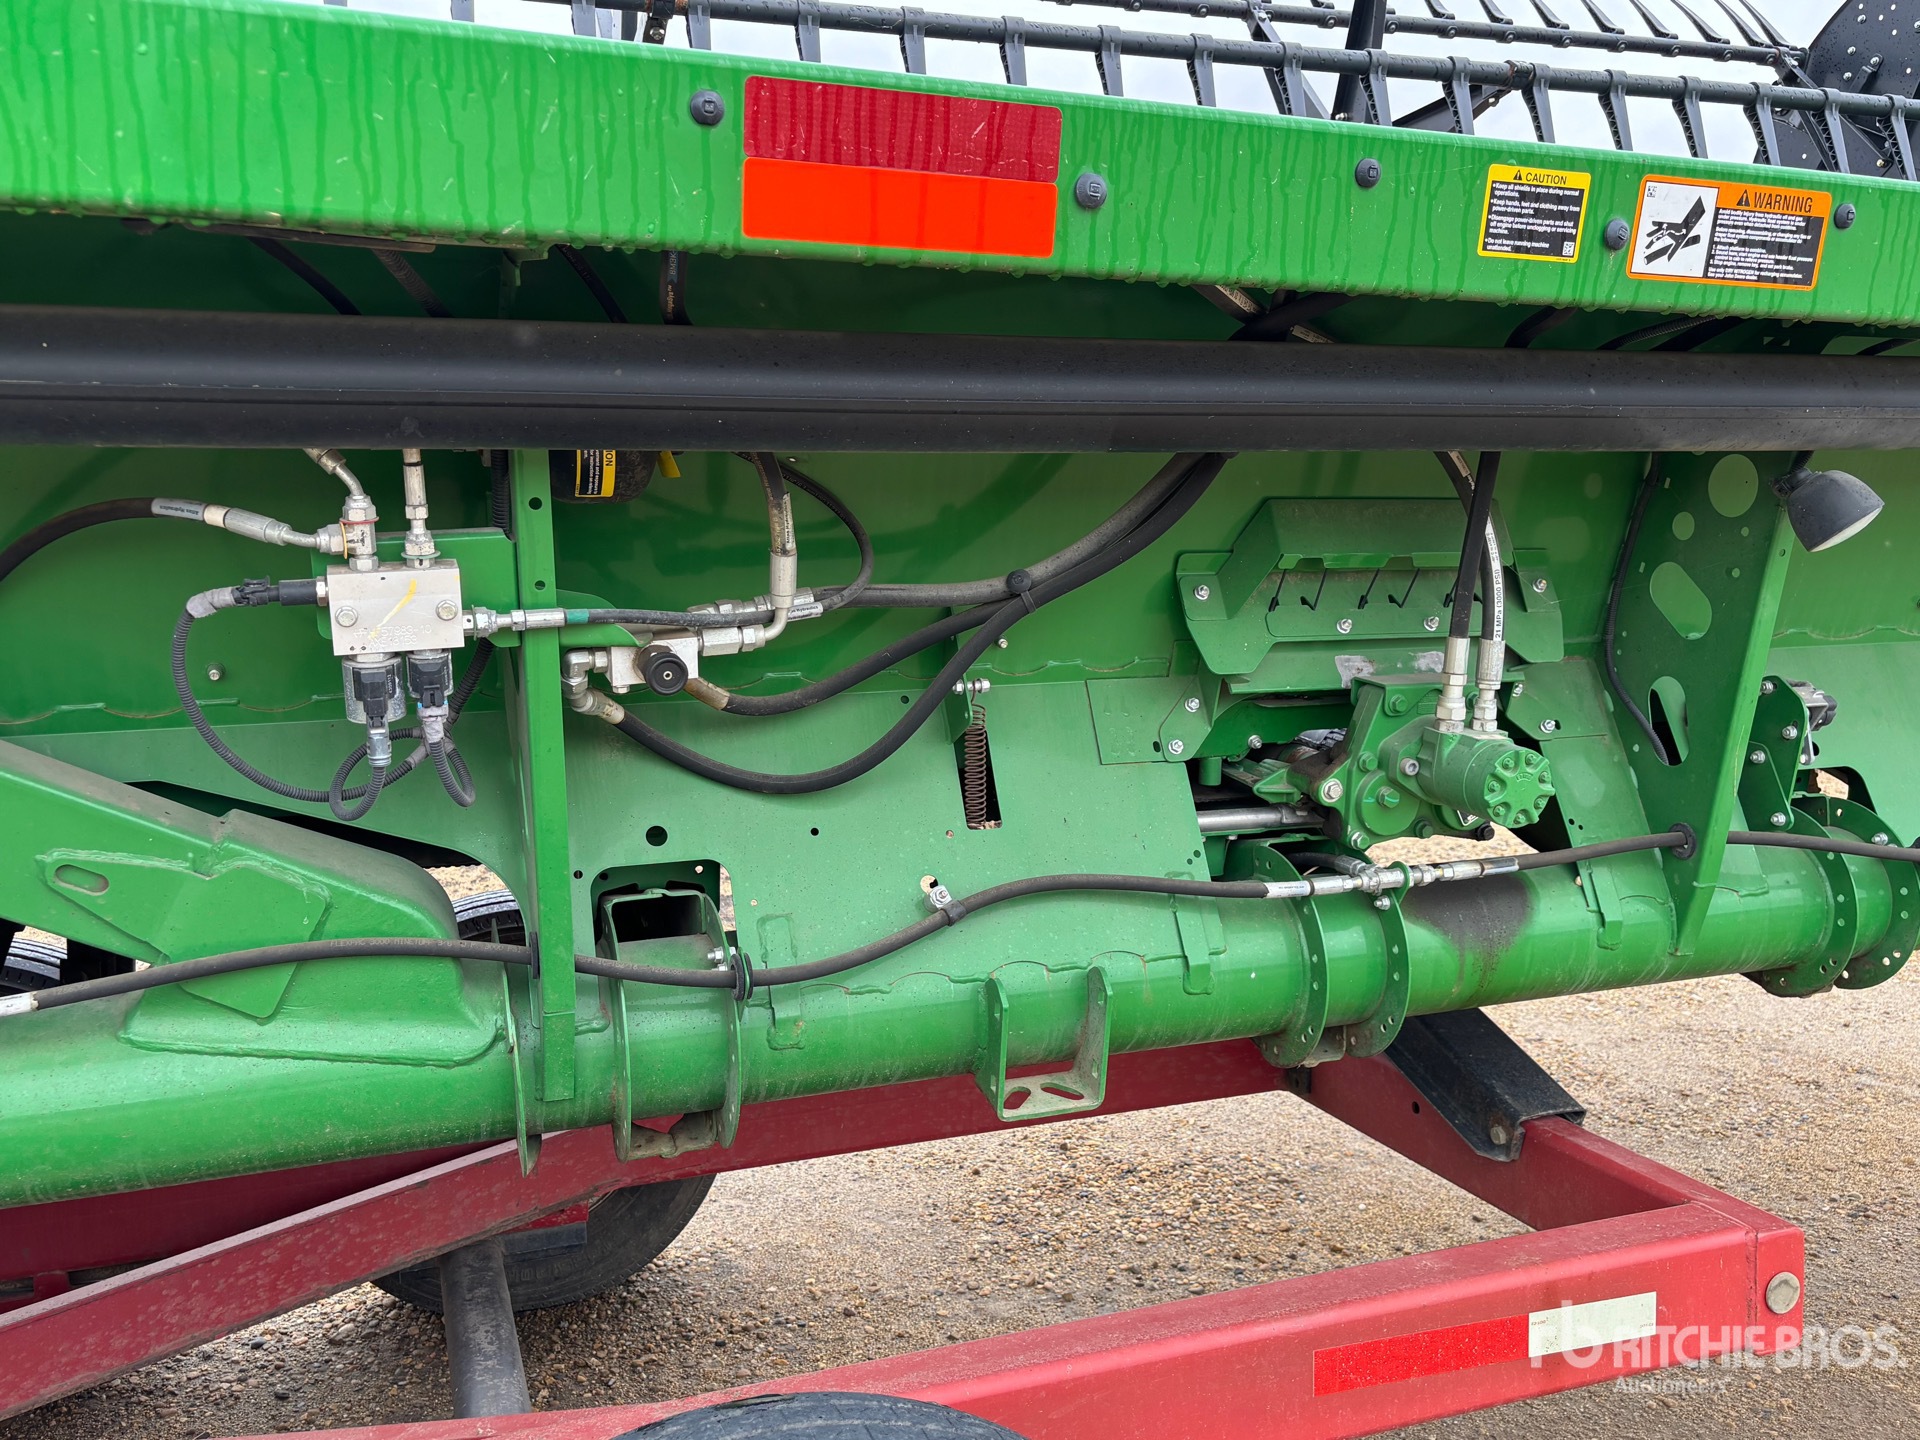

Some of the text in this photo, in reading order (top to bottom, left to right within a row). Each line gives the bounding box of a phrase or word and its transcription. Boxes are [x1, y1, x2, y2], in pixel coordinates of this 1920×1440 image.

[1525, 172, 1567, 185] CAUTION
[1754, 192, 1813, 213] WARNING
[1494, 569, 1502, 585] PSI)
[1495, 628, 1501, 639] 21
